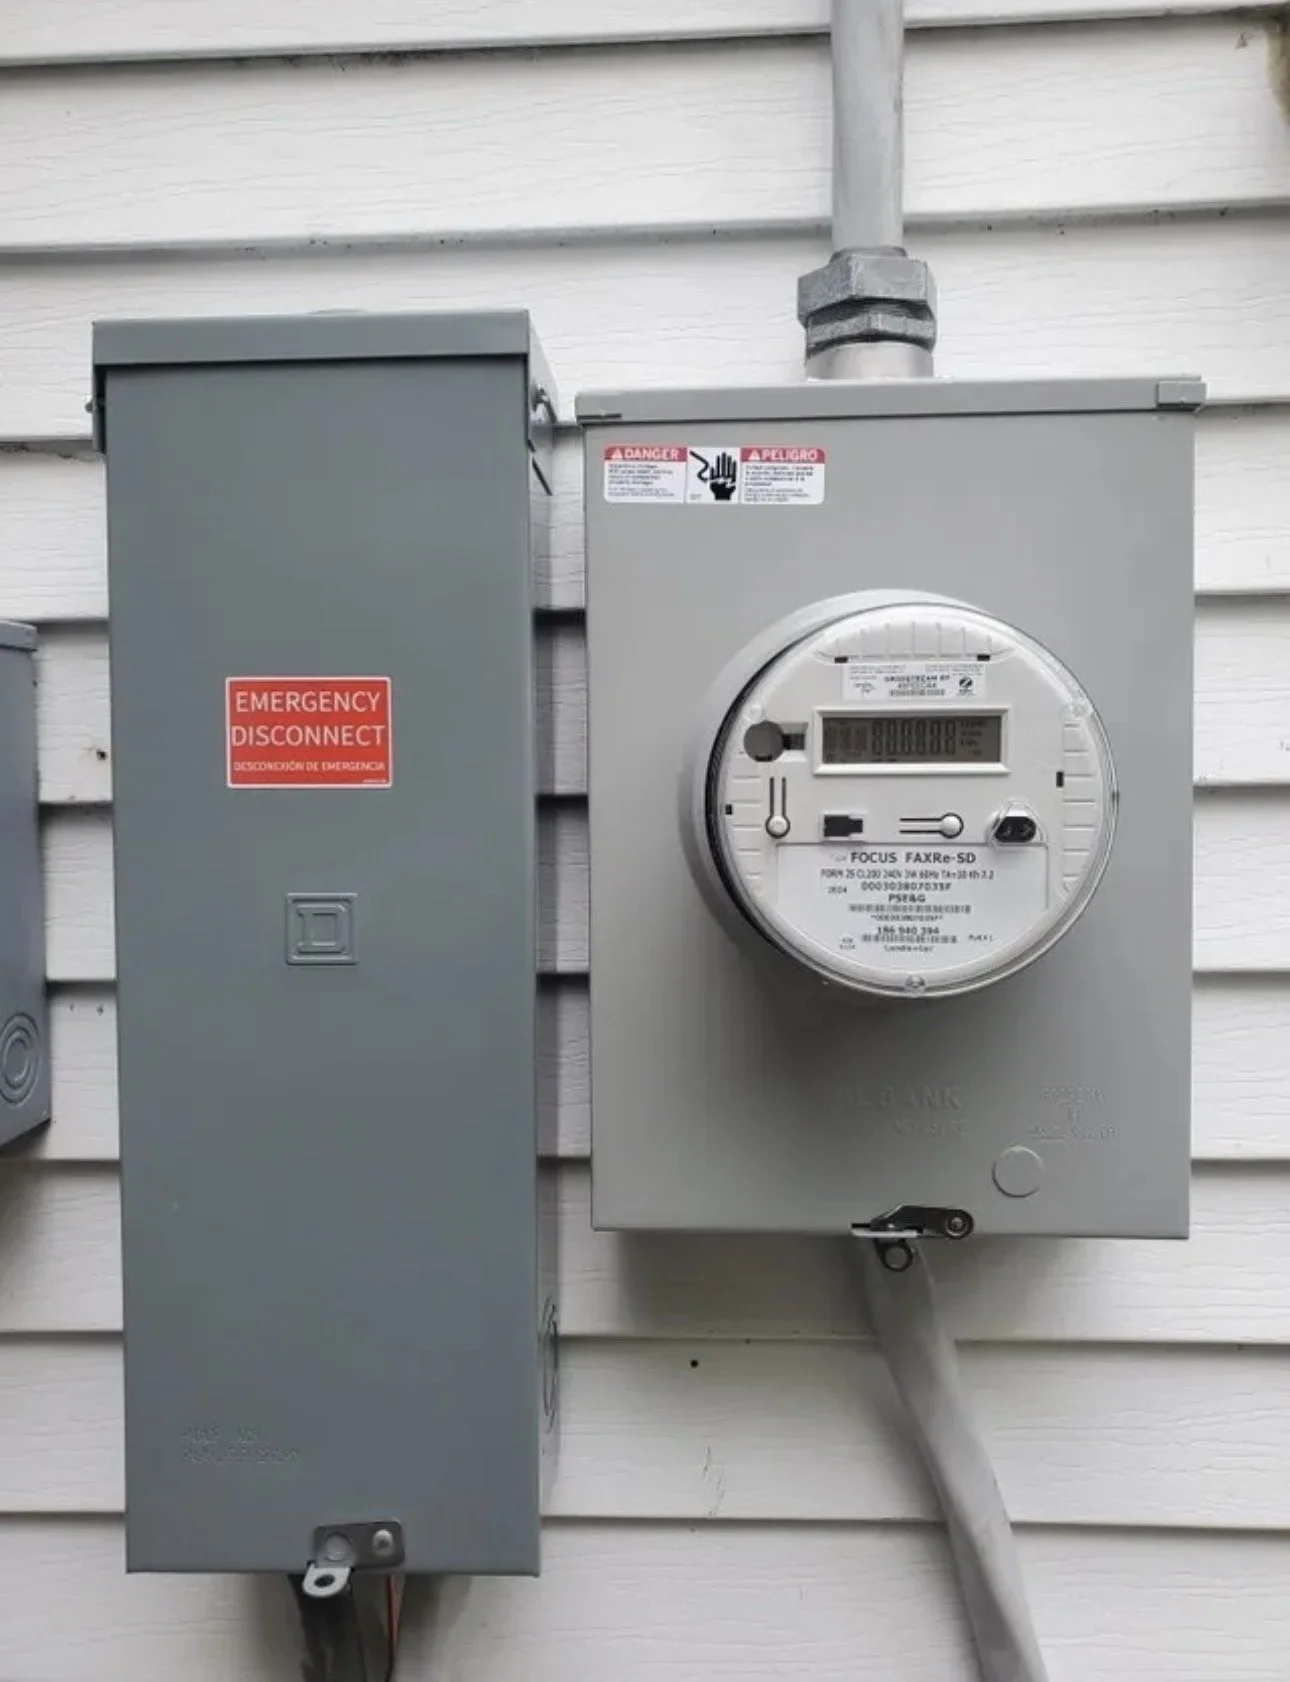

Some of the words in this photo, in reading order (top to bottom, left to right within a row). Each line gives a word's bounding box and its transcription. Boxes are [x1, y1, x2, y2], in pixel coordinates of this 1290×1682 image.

[624, 447, 679, 460] DANGER
[762, 448, 818, 461] PELIGRO
[235, 690, 381, 713] EMERGENCY
[231, 725, 386, 747] DISCONNECT
[306, 761, 318, 772] DE
[321, 761, 386, 772] EMERGENCIA
[850, 851, 898, 864] FOCUS
[905, 851, 977, 864] FAXRe-SD
[821, 868, 843, 878] FORM
[888, 893, 927, 903] PSE&G
